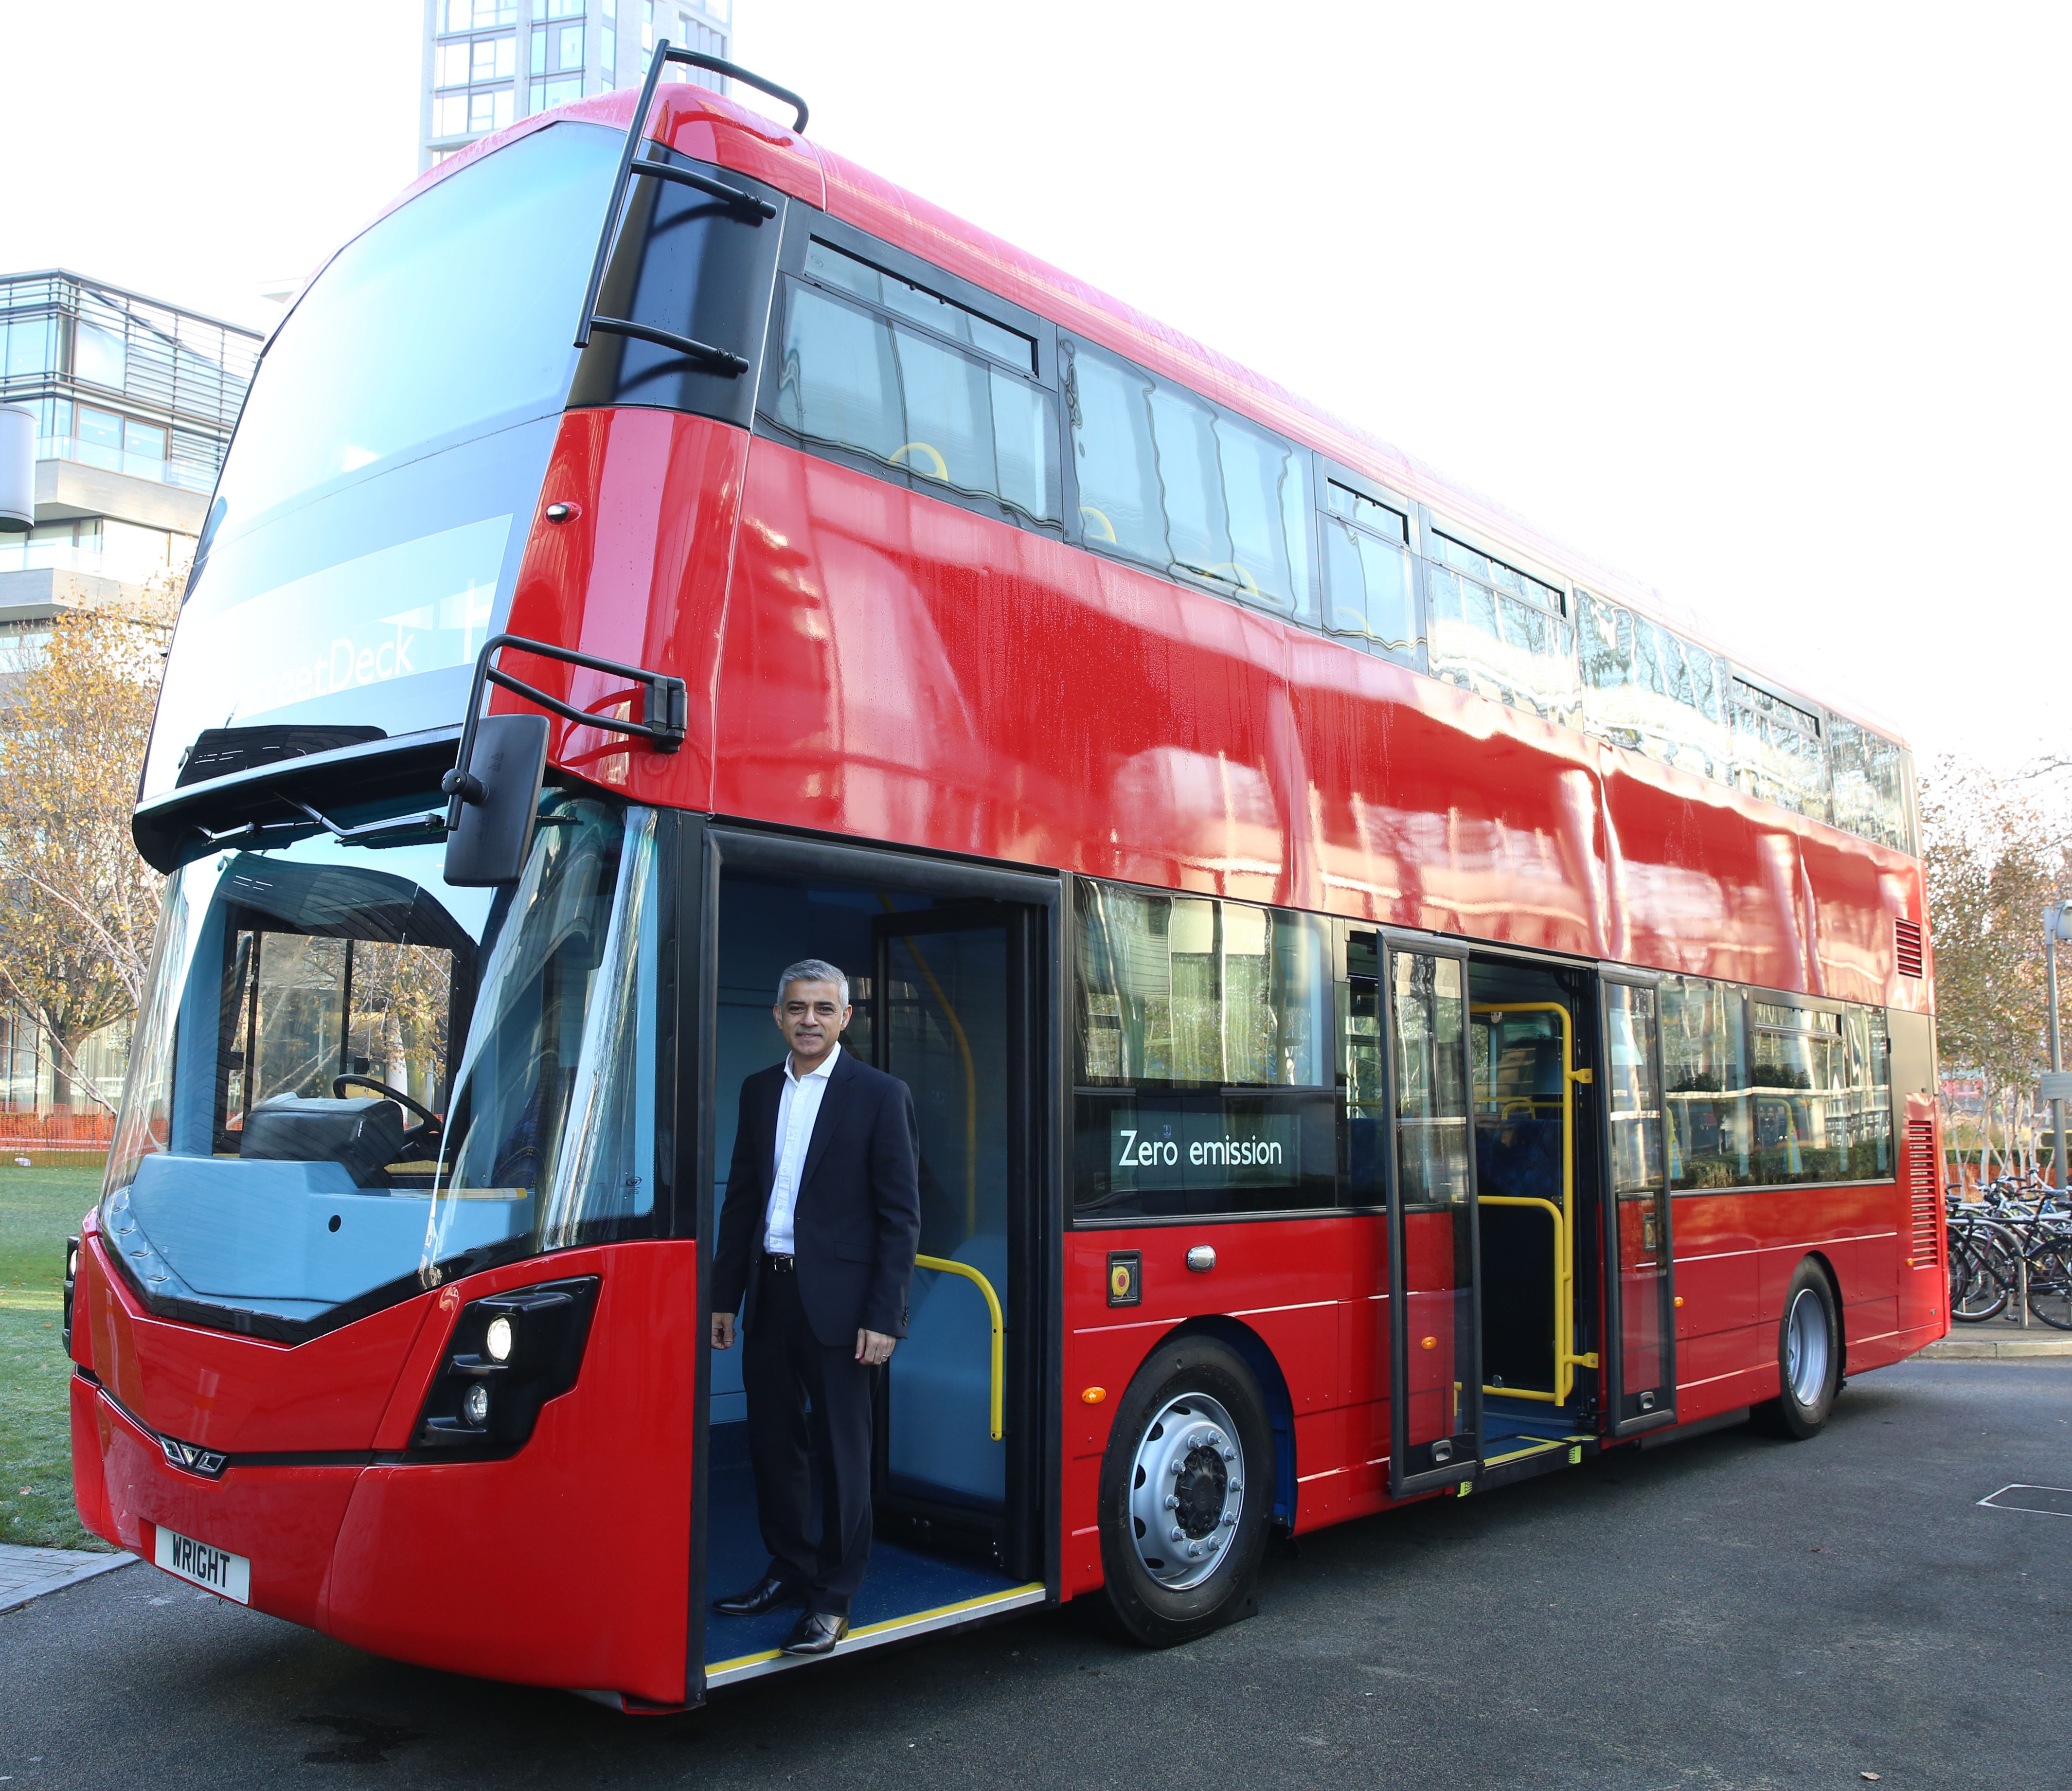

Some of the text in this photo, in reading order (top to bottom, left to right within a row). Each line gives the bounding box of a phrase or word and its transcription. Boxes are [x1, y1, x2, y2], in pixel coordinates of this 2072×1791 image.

[1119, 1130, 1282, 1166] Zero emission
[173, 1534, 230, 1588] WRIGHT
